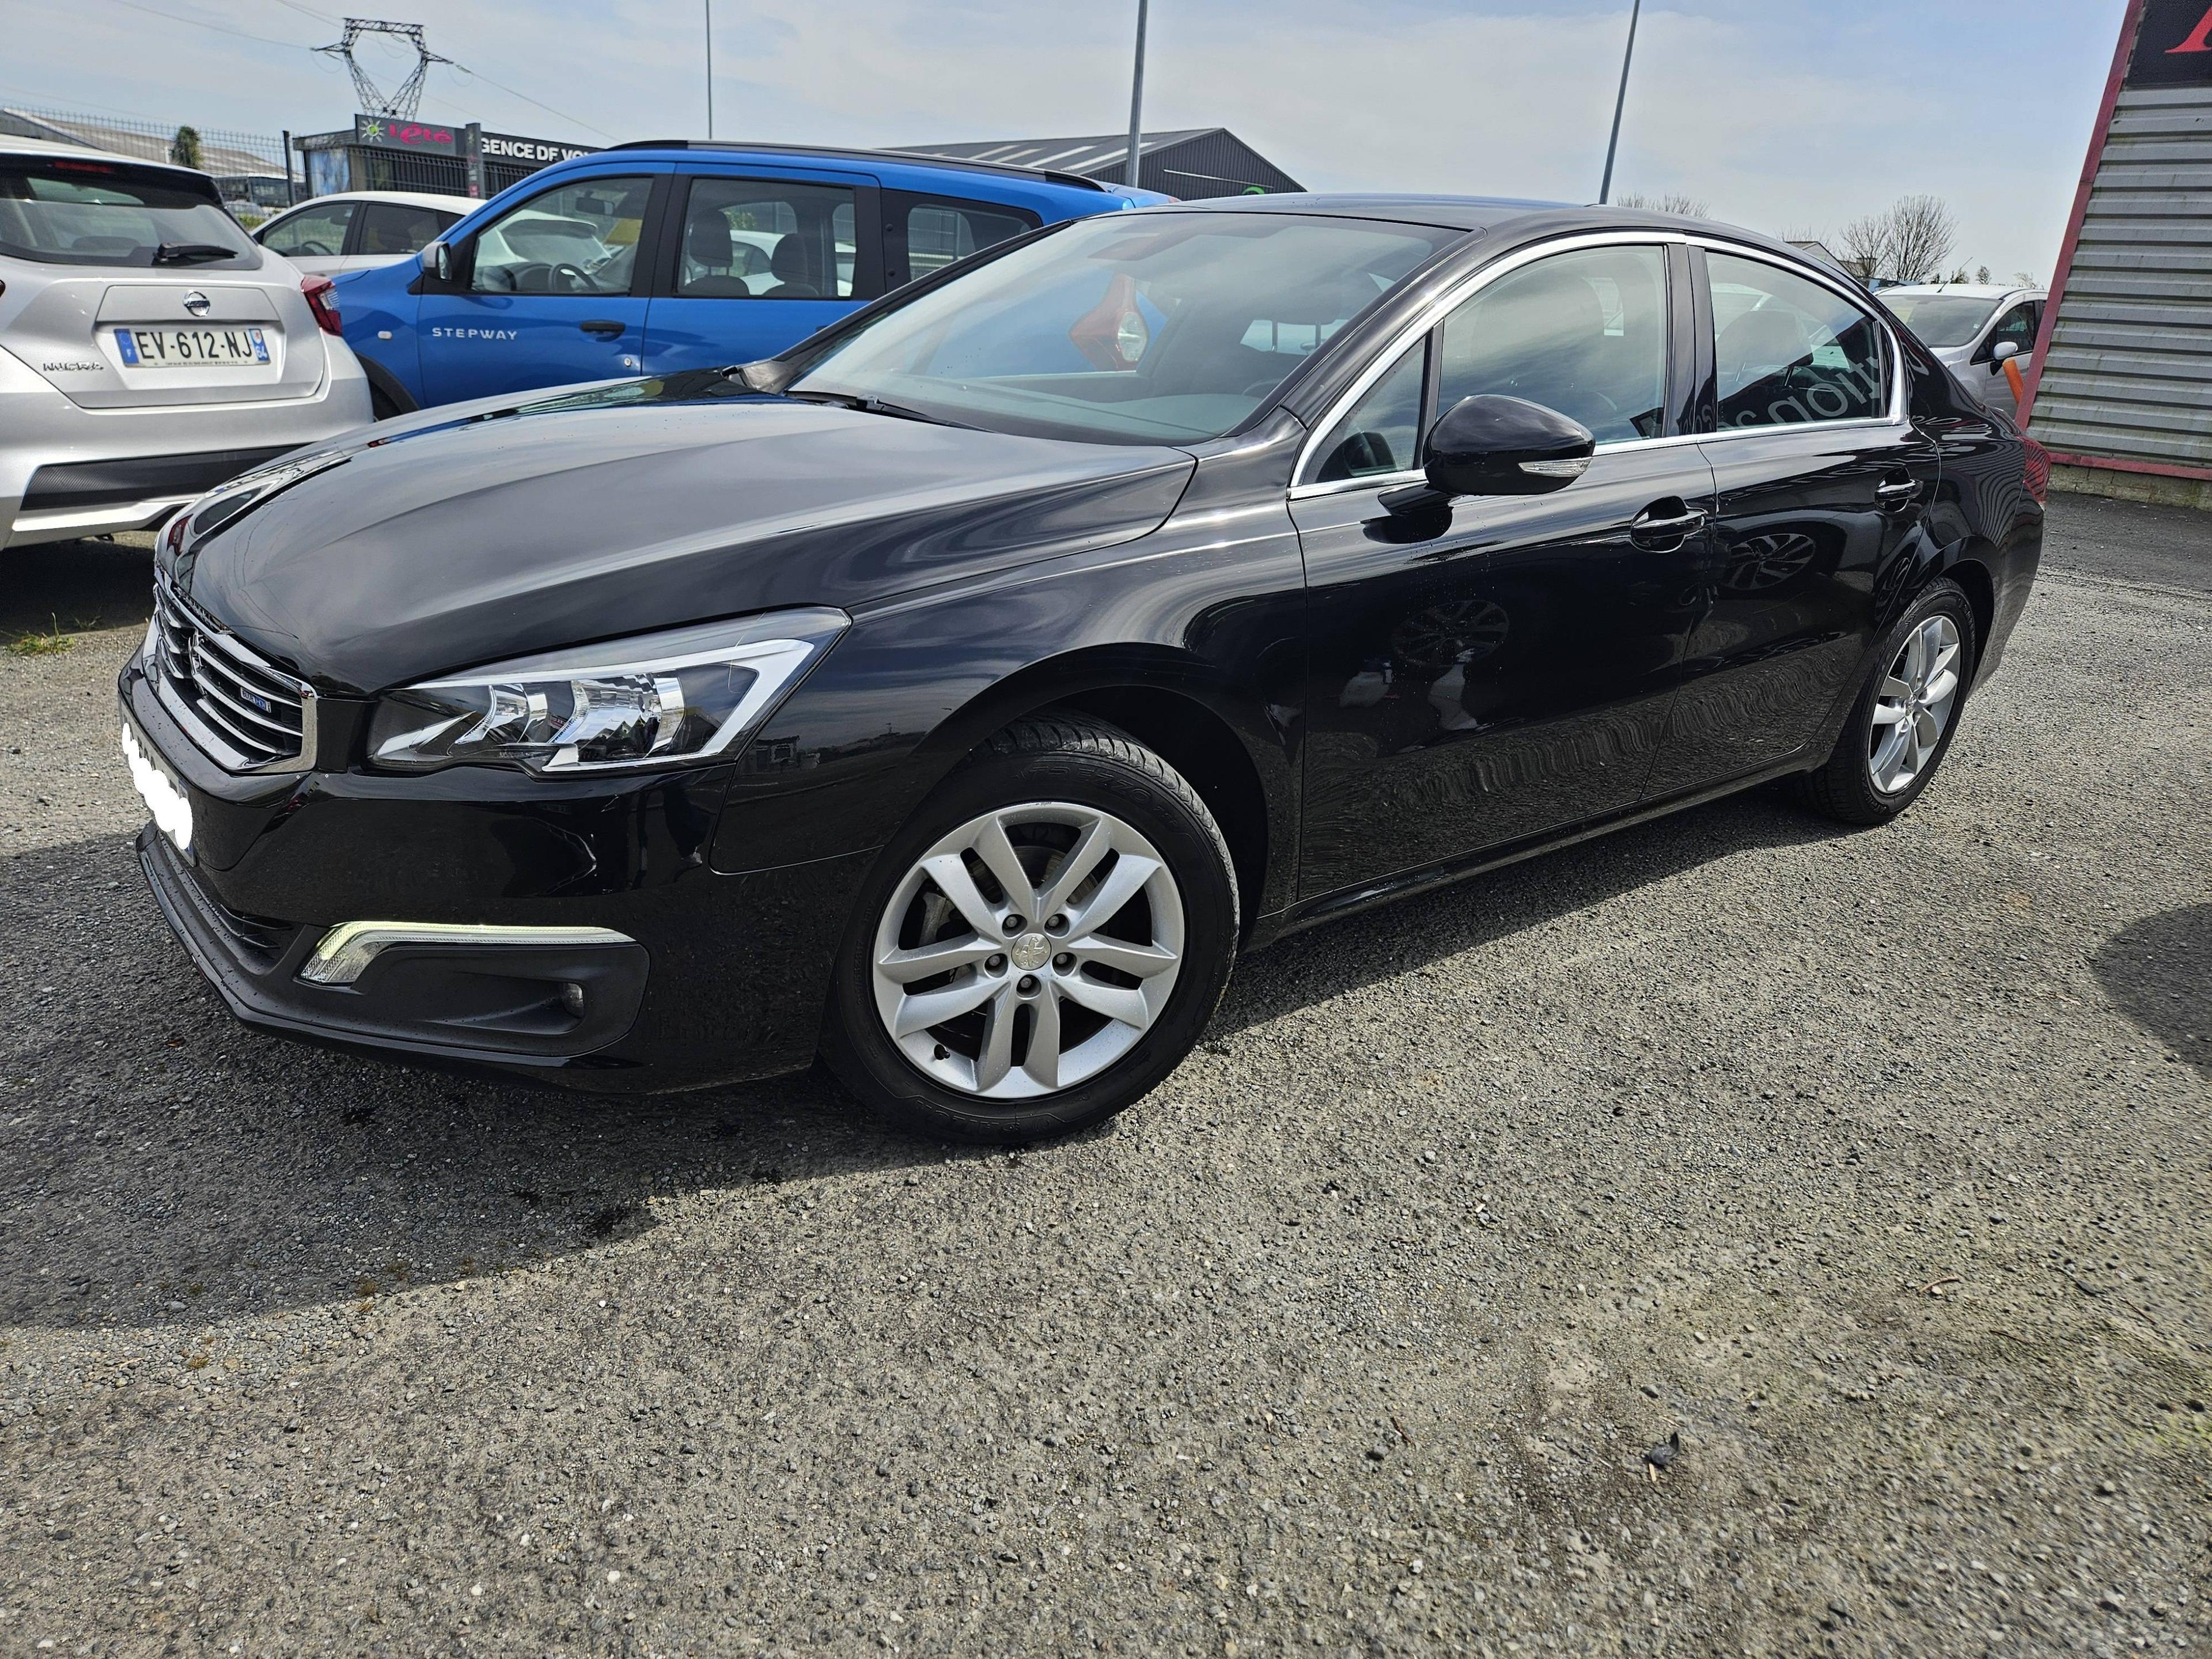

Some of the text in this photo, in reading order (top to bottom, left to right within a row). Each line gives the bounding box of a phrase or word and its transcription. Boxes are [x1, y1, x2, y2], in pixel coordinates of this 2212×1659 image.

[481, 138, 535, 160] GENCE
[432, 327, 517, 340] STEPWAY
[135, 331, 252, 359] EV-612-NJ
